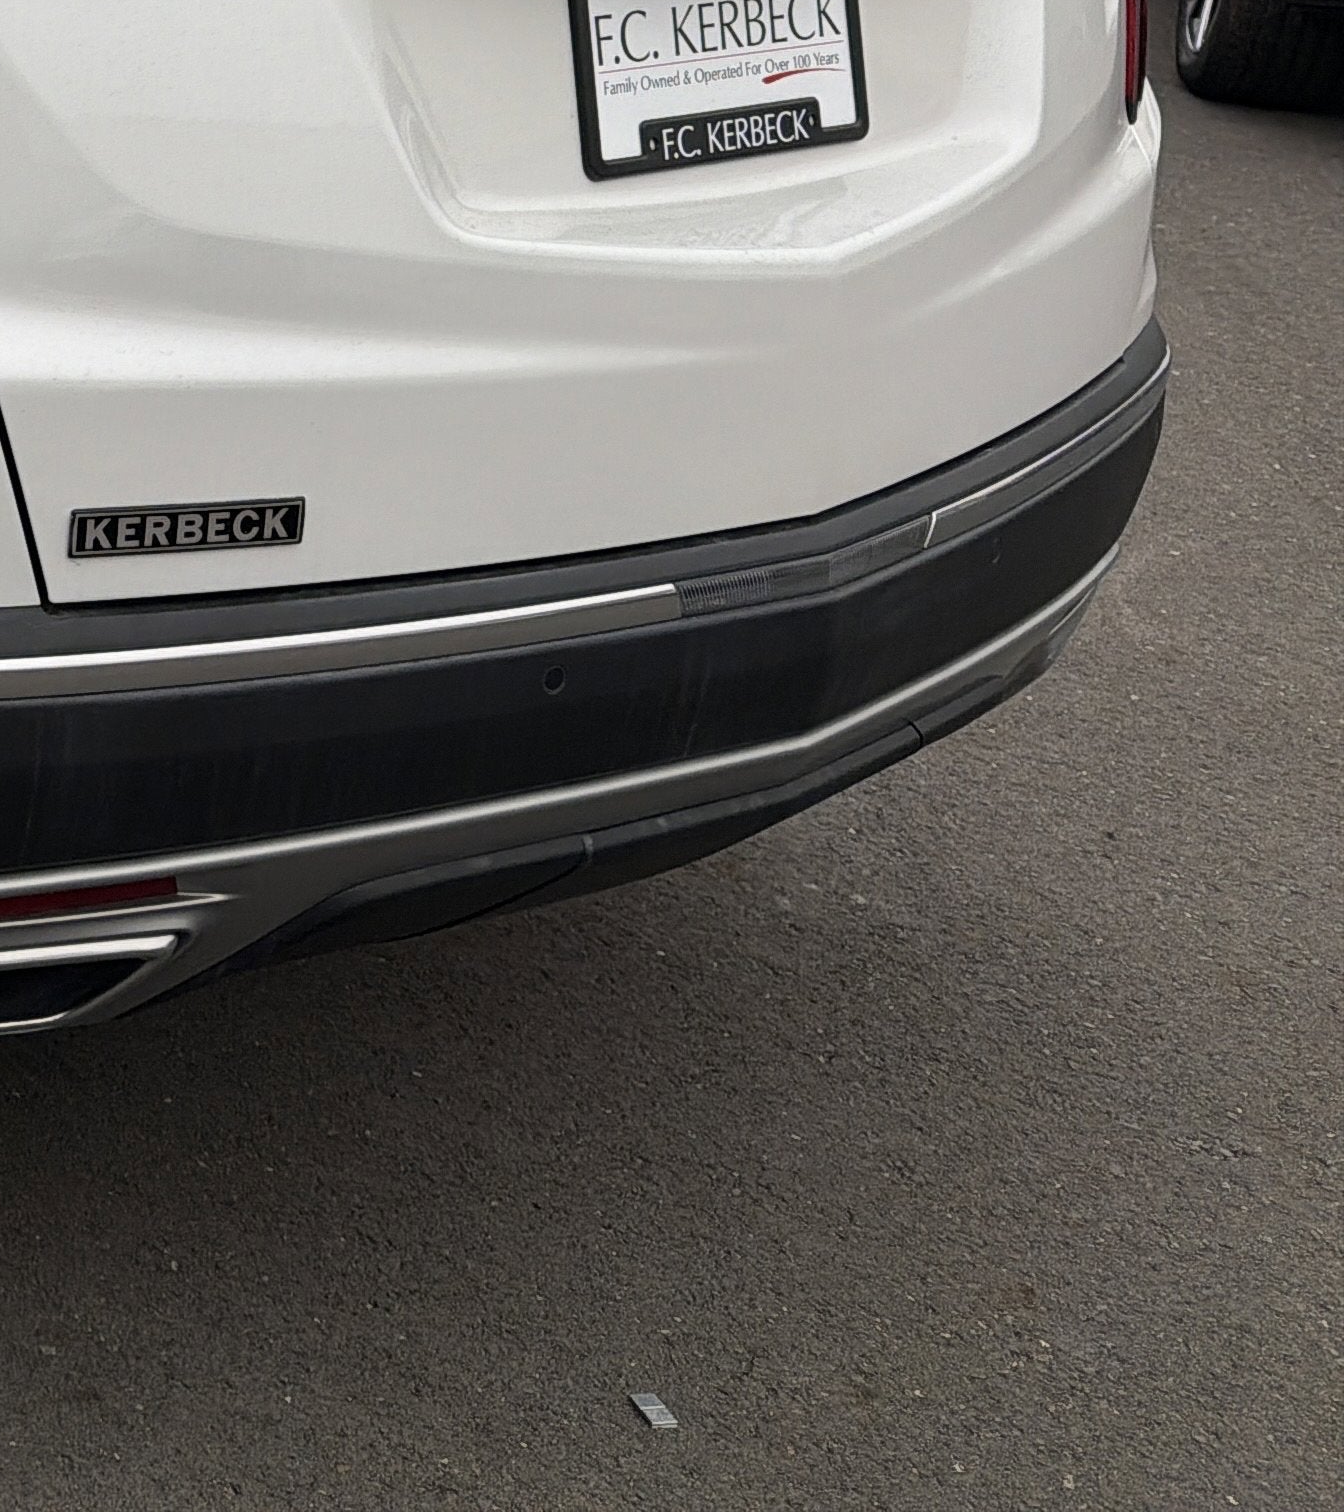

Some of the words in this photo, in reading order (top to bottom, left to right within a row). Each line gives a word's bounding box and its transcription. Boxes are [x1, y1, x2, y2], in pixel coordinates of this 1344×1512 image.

[593, 10, 660, 67] F.C.
[603, 75, 639, 96] Family
[640, 70, 681, 92] Owned
[683, 70, 692, 85] &
[694, 62, 744, 86] Operated
[745, 60, 762, 78] For
[764, 57, 791, 74] Over
[793, 53, 812, 69] 100
[813, 51, 840, 68] Years
[662, 125, 702, 161] F.C.
[706, 108, 811, 155] KERBECK
[84, 507, 291, 551] KERBECK
